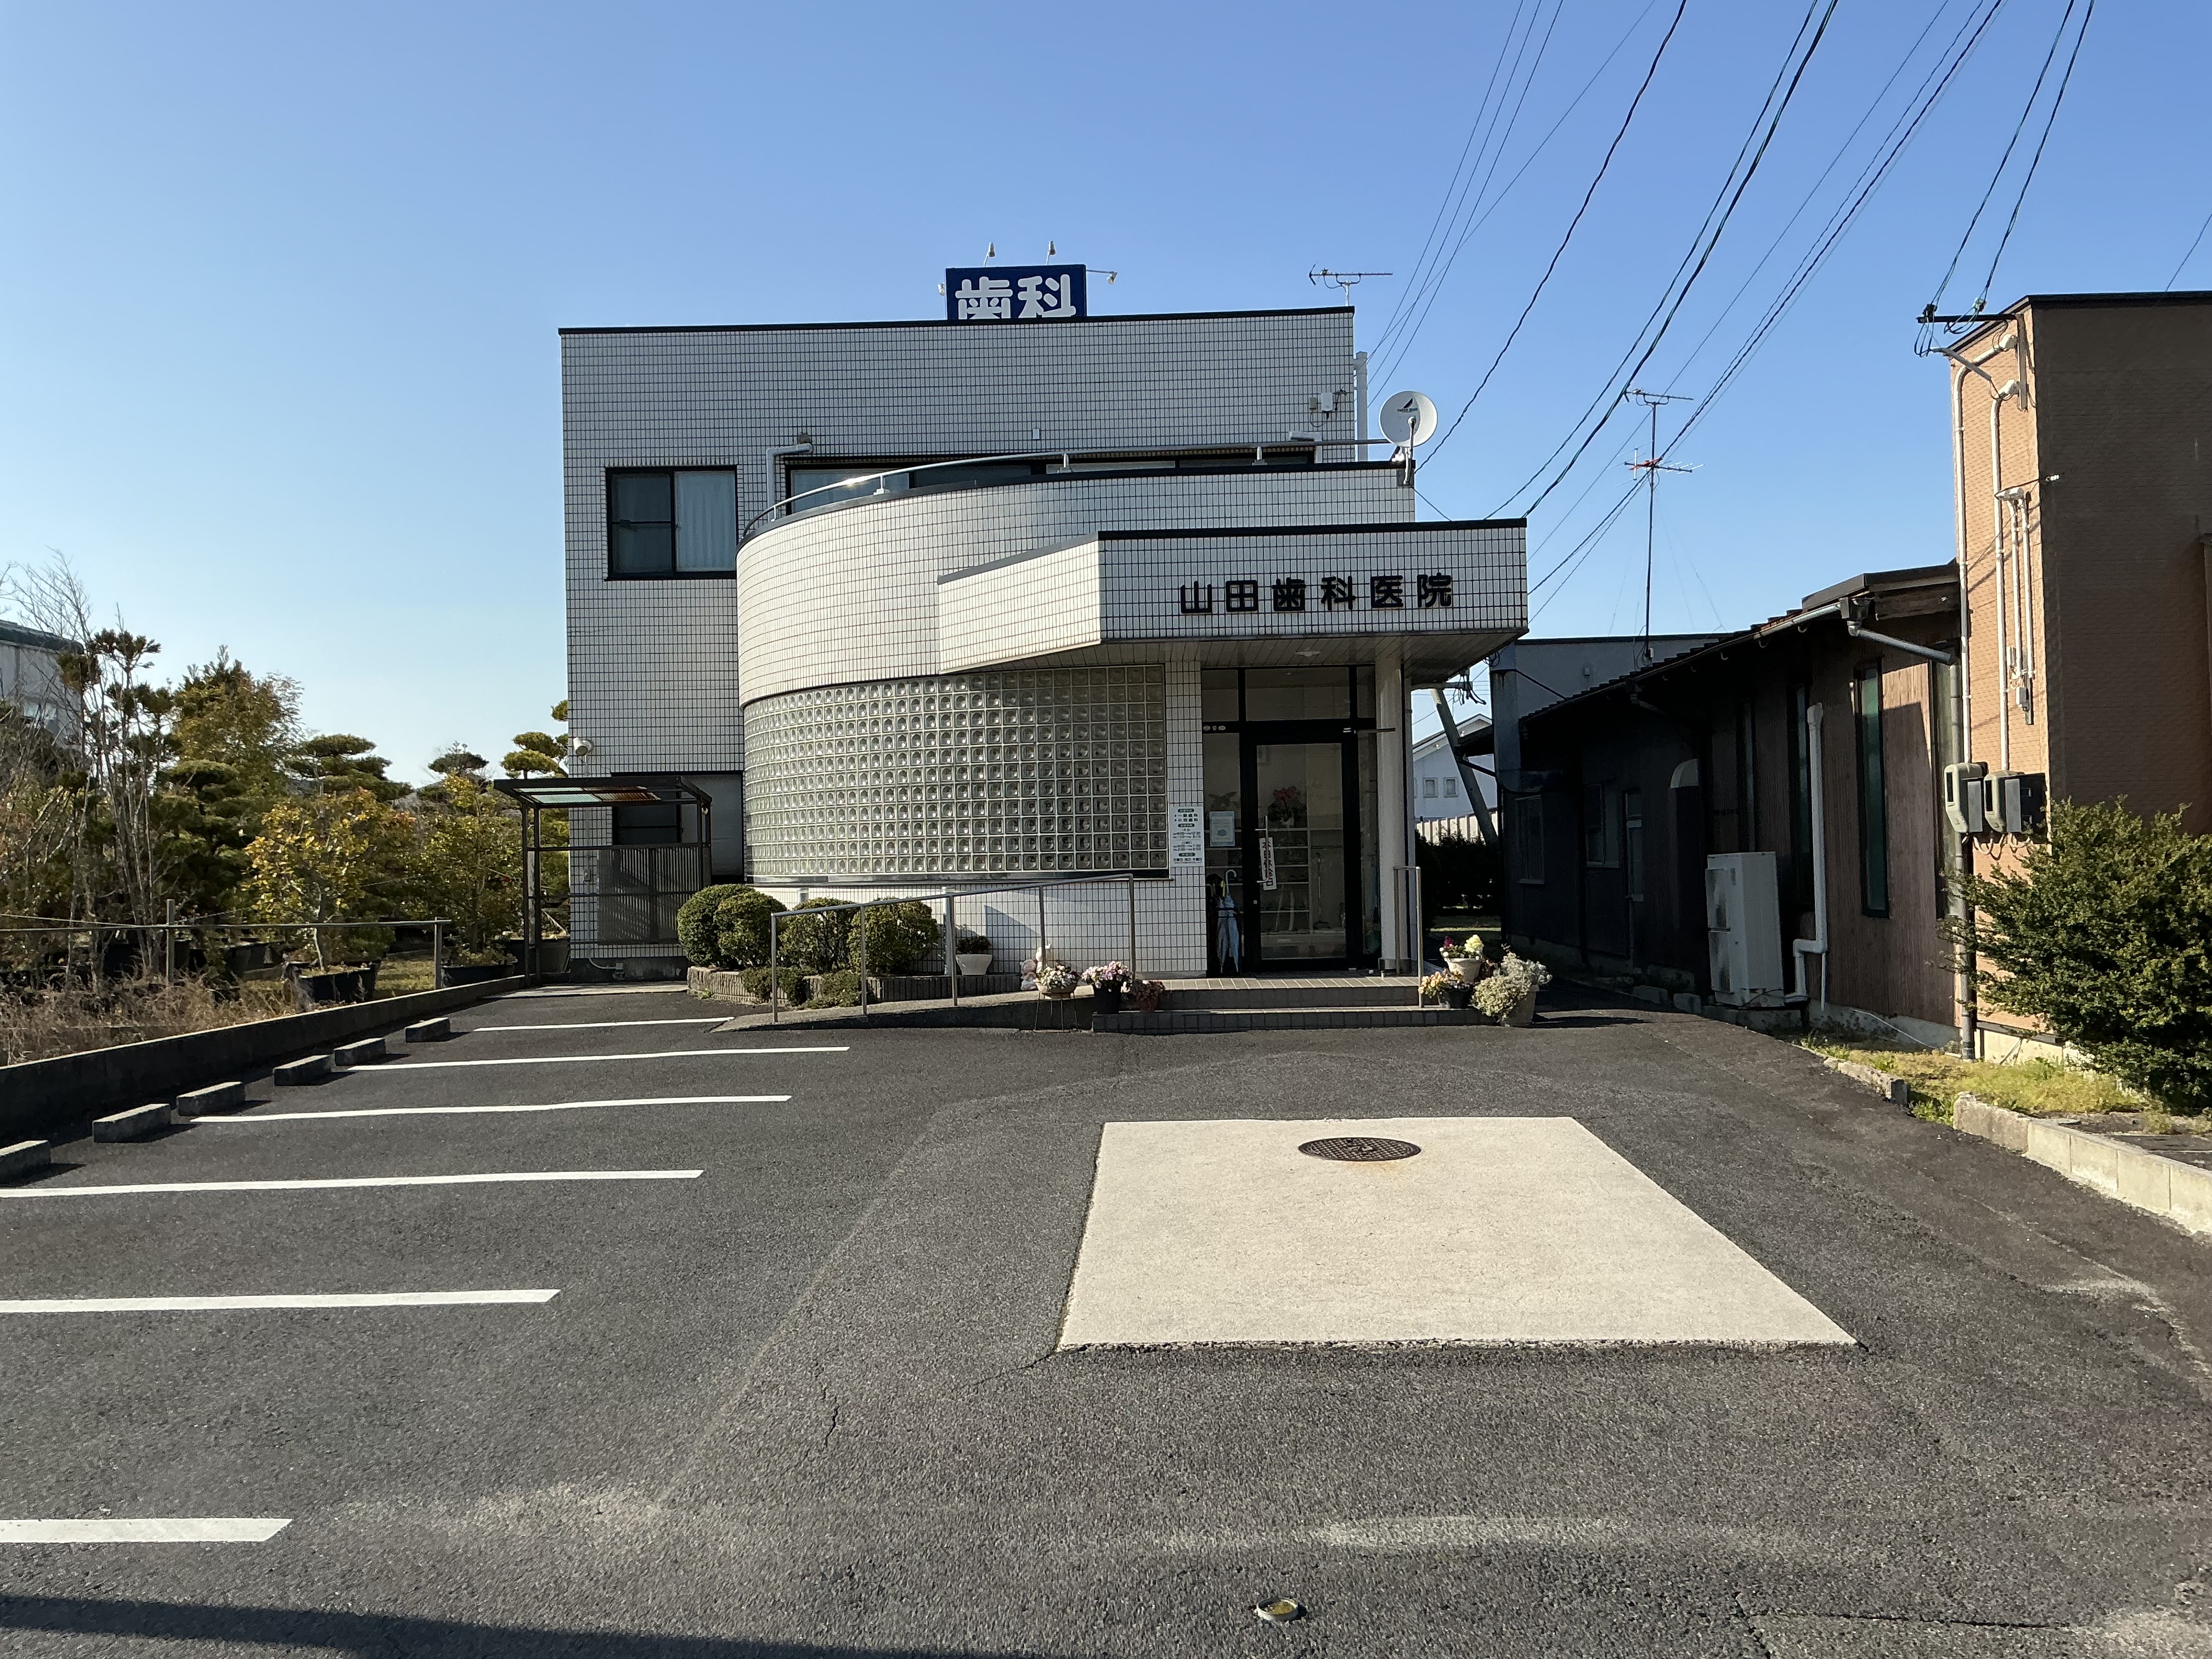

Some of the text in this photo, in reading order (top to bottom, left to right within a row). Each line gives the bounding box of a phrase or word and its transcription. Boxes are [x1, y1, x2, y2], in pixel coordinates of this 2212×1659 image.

[955, 274, 1076, 320] 歯科
[1180, 572, 1452, 614] 山田歯科医院
